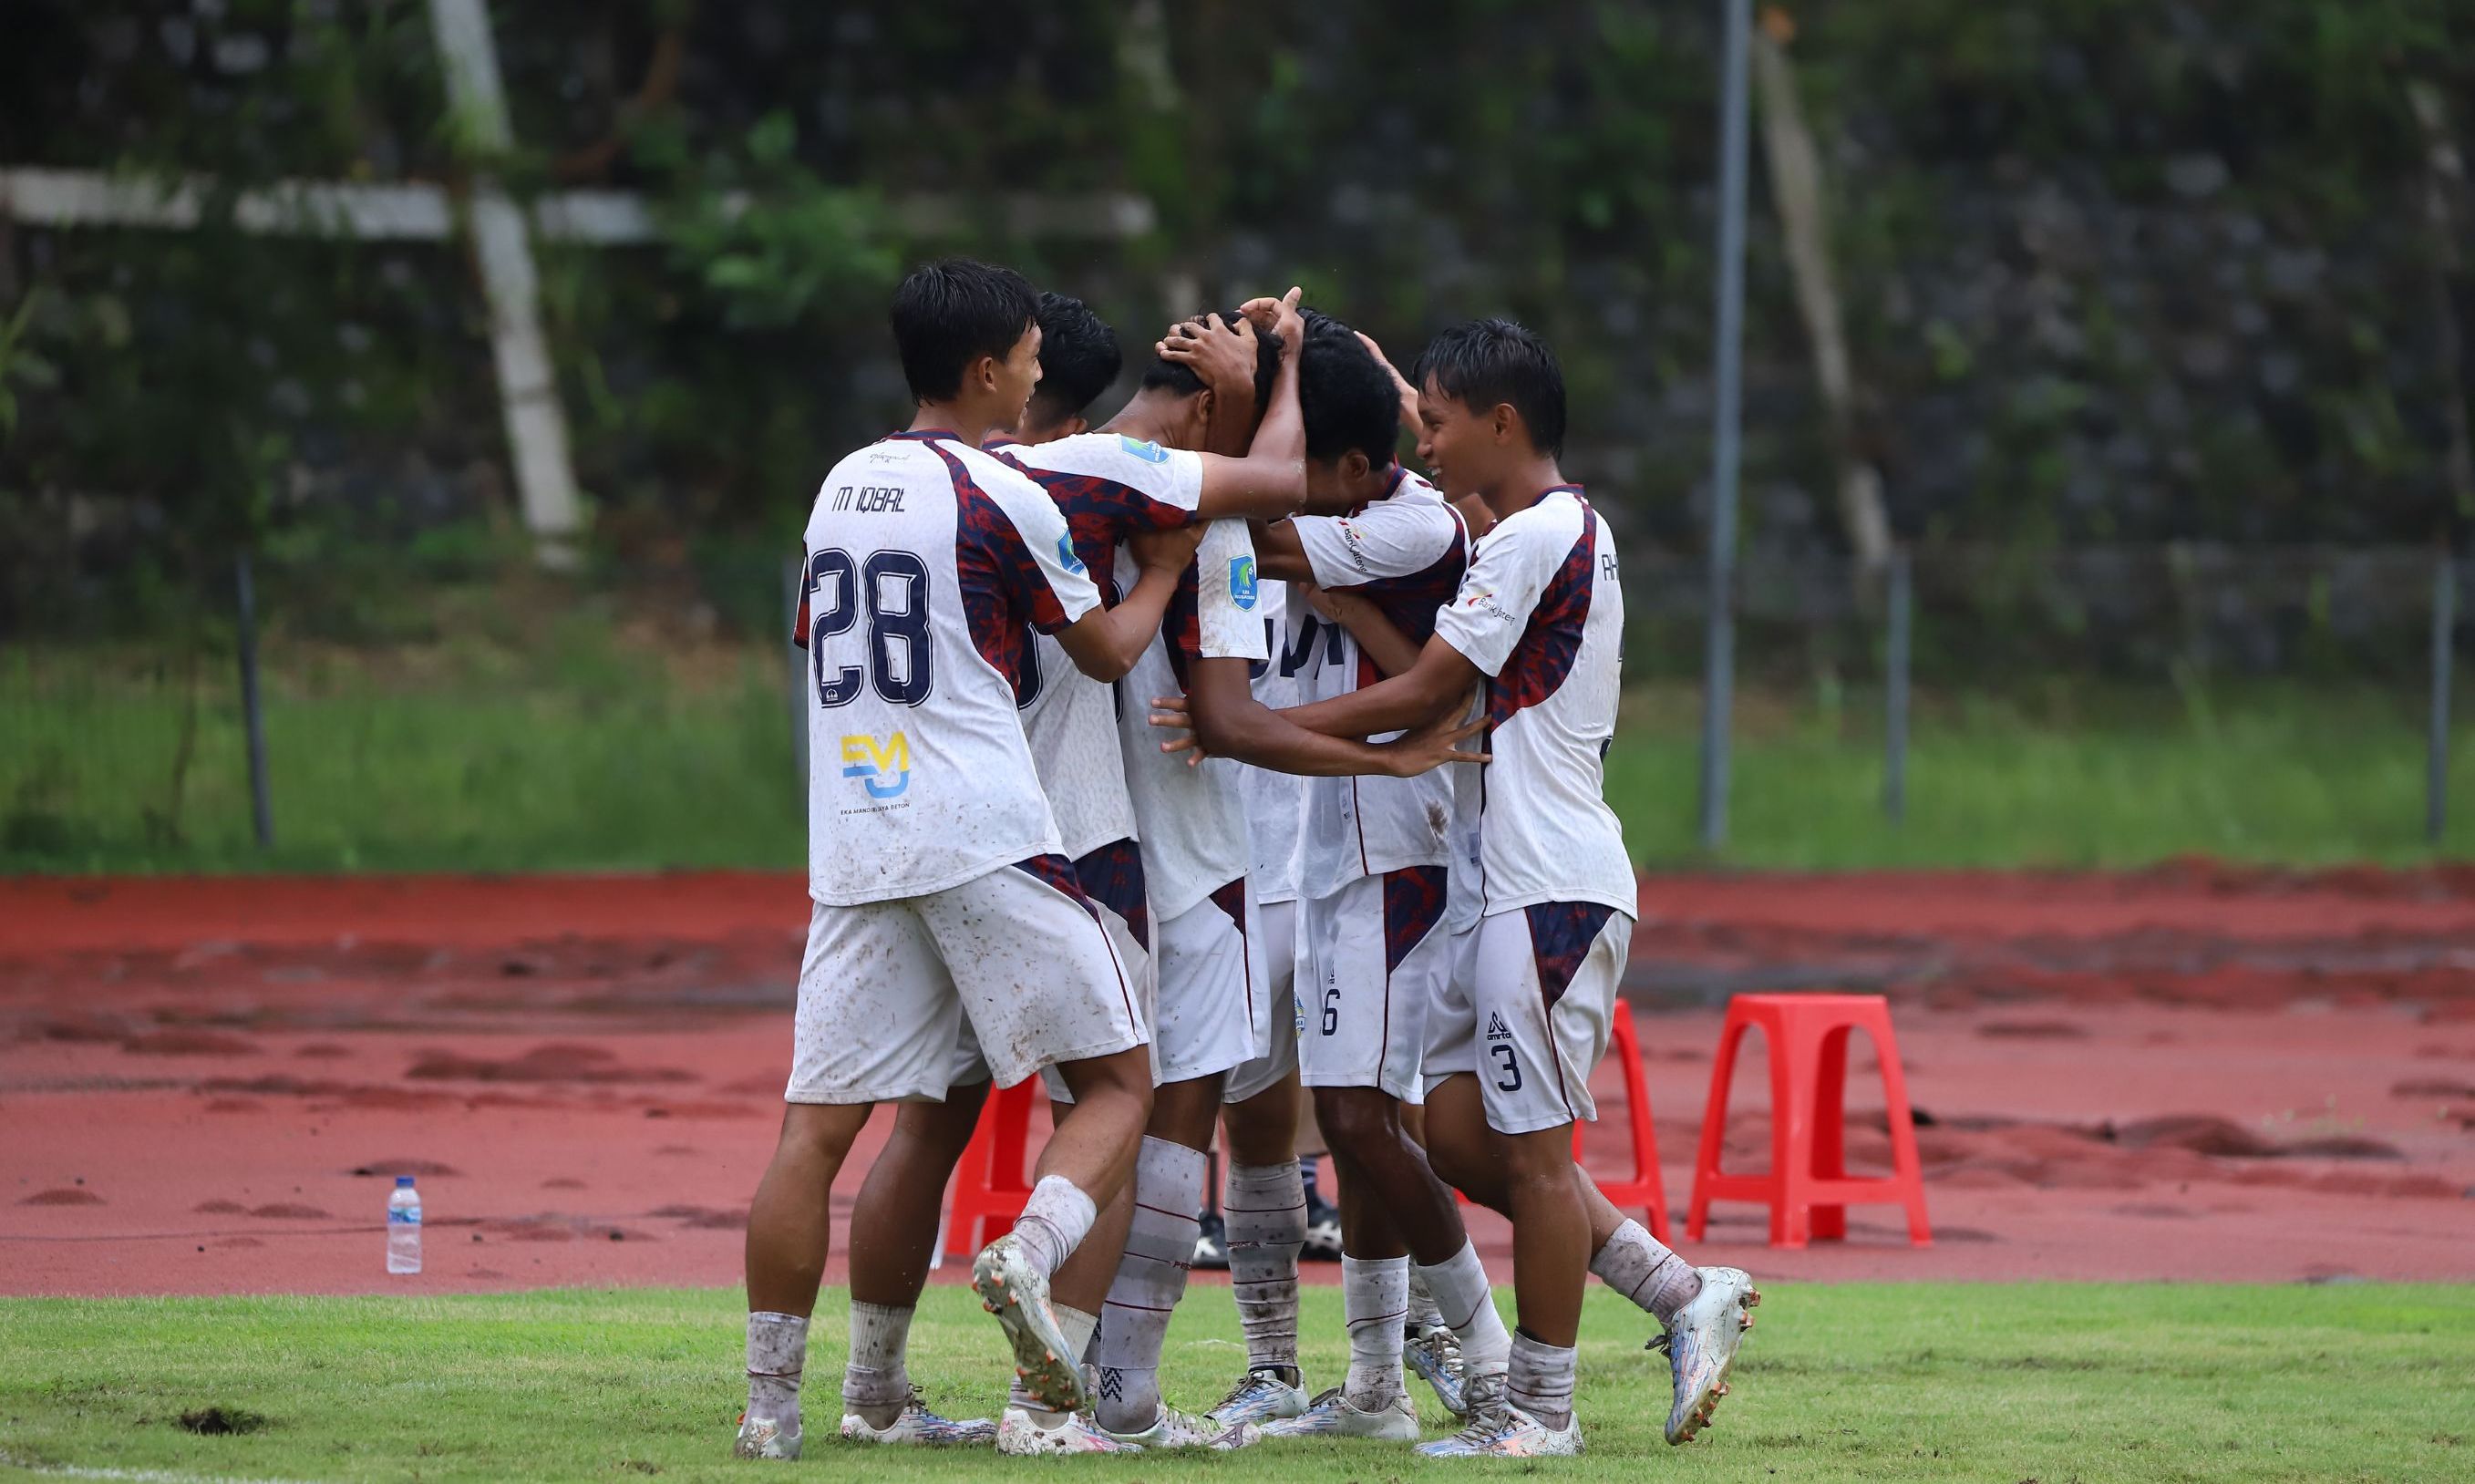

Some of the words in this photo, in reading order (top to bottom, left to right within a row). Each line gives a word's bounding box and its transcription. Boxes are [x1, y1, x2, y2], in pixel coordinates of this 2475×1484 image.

[831, 486, 853, 511] M
[855, 486, 905, 513] IQBAL
[1601, 553, 1620, 581] AH
[1478, 597, 1497, 613] Bank
[810, 548, 933, 707] 28
[890, 801, 911, 810] BETON
[1487, 1032, 1511, 1041] amrta
[1490, 1044, 1522, 1092] 3
